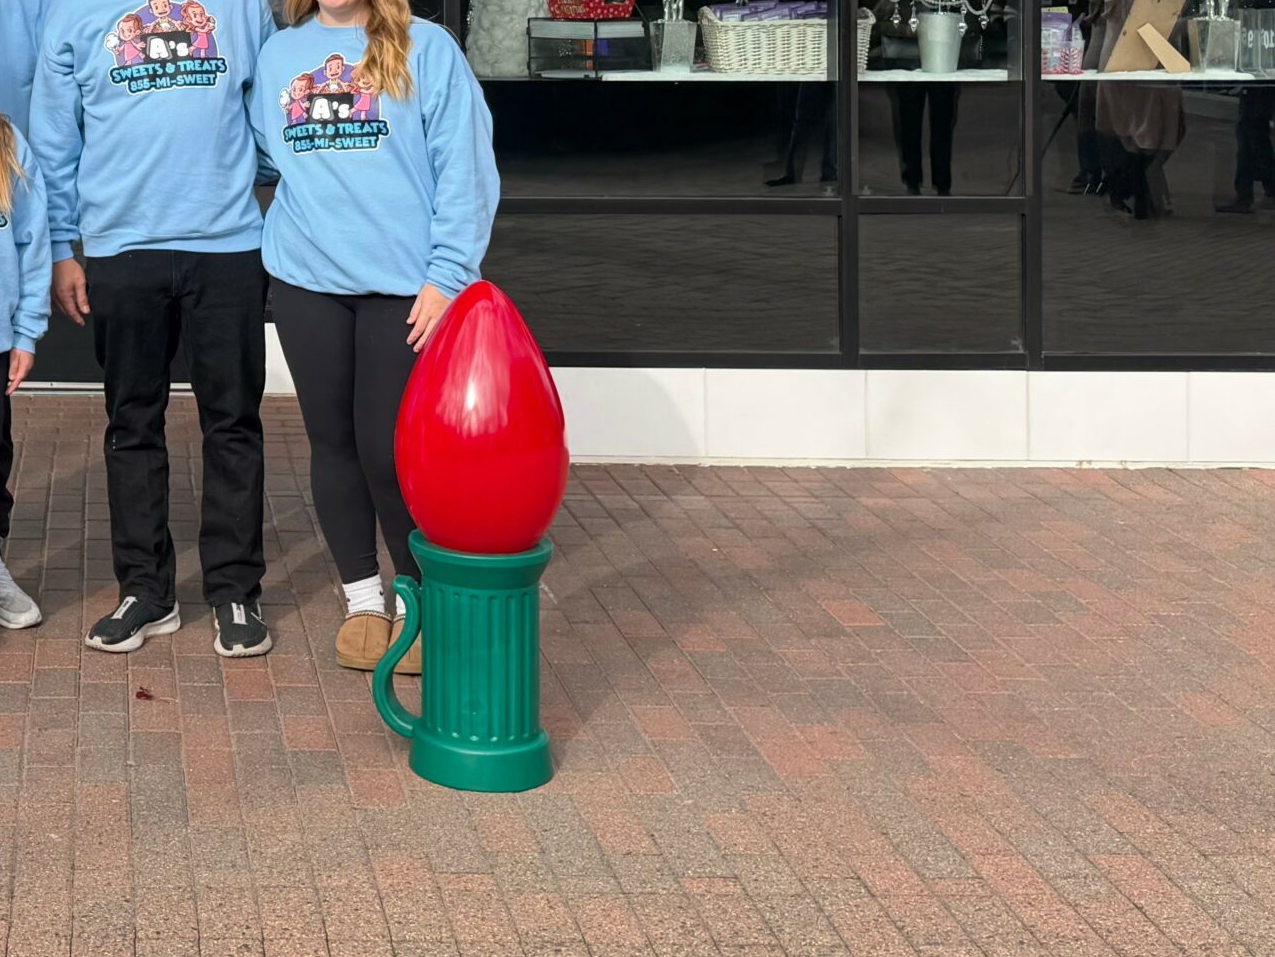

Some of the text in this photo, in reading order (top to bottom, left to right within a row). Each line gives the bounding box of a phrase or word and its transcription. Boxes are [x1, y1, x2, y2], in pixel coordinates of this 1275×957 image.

[149, 38, 189, 59] A's
[112, 59, 226, 82] SWEETS & TREATS
[130, 74, 215, 91] 855-MI-SWEET
[312, 97, 350, 120] A's
[326, 123, 336, 135] &
[337, 122, 388, 134] TREATS
